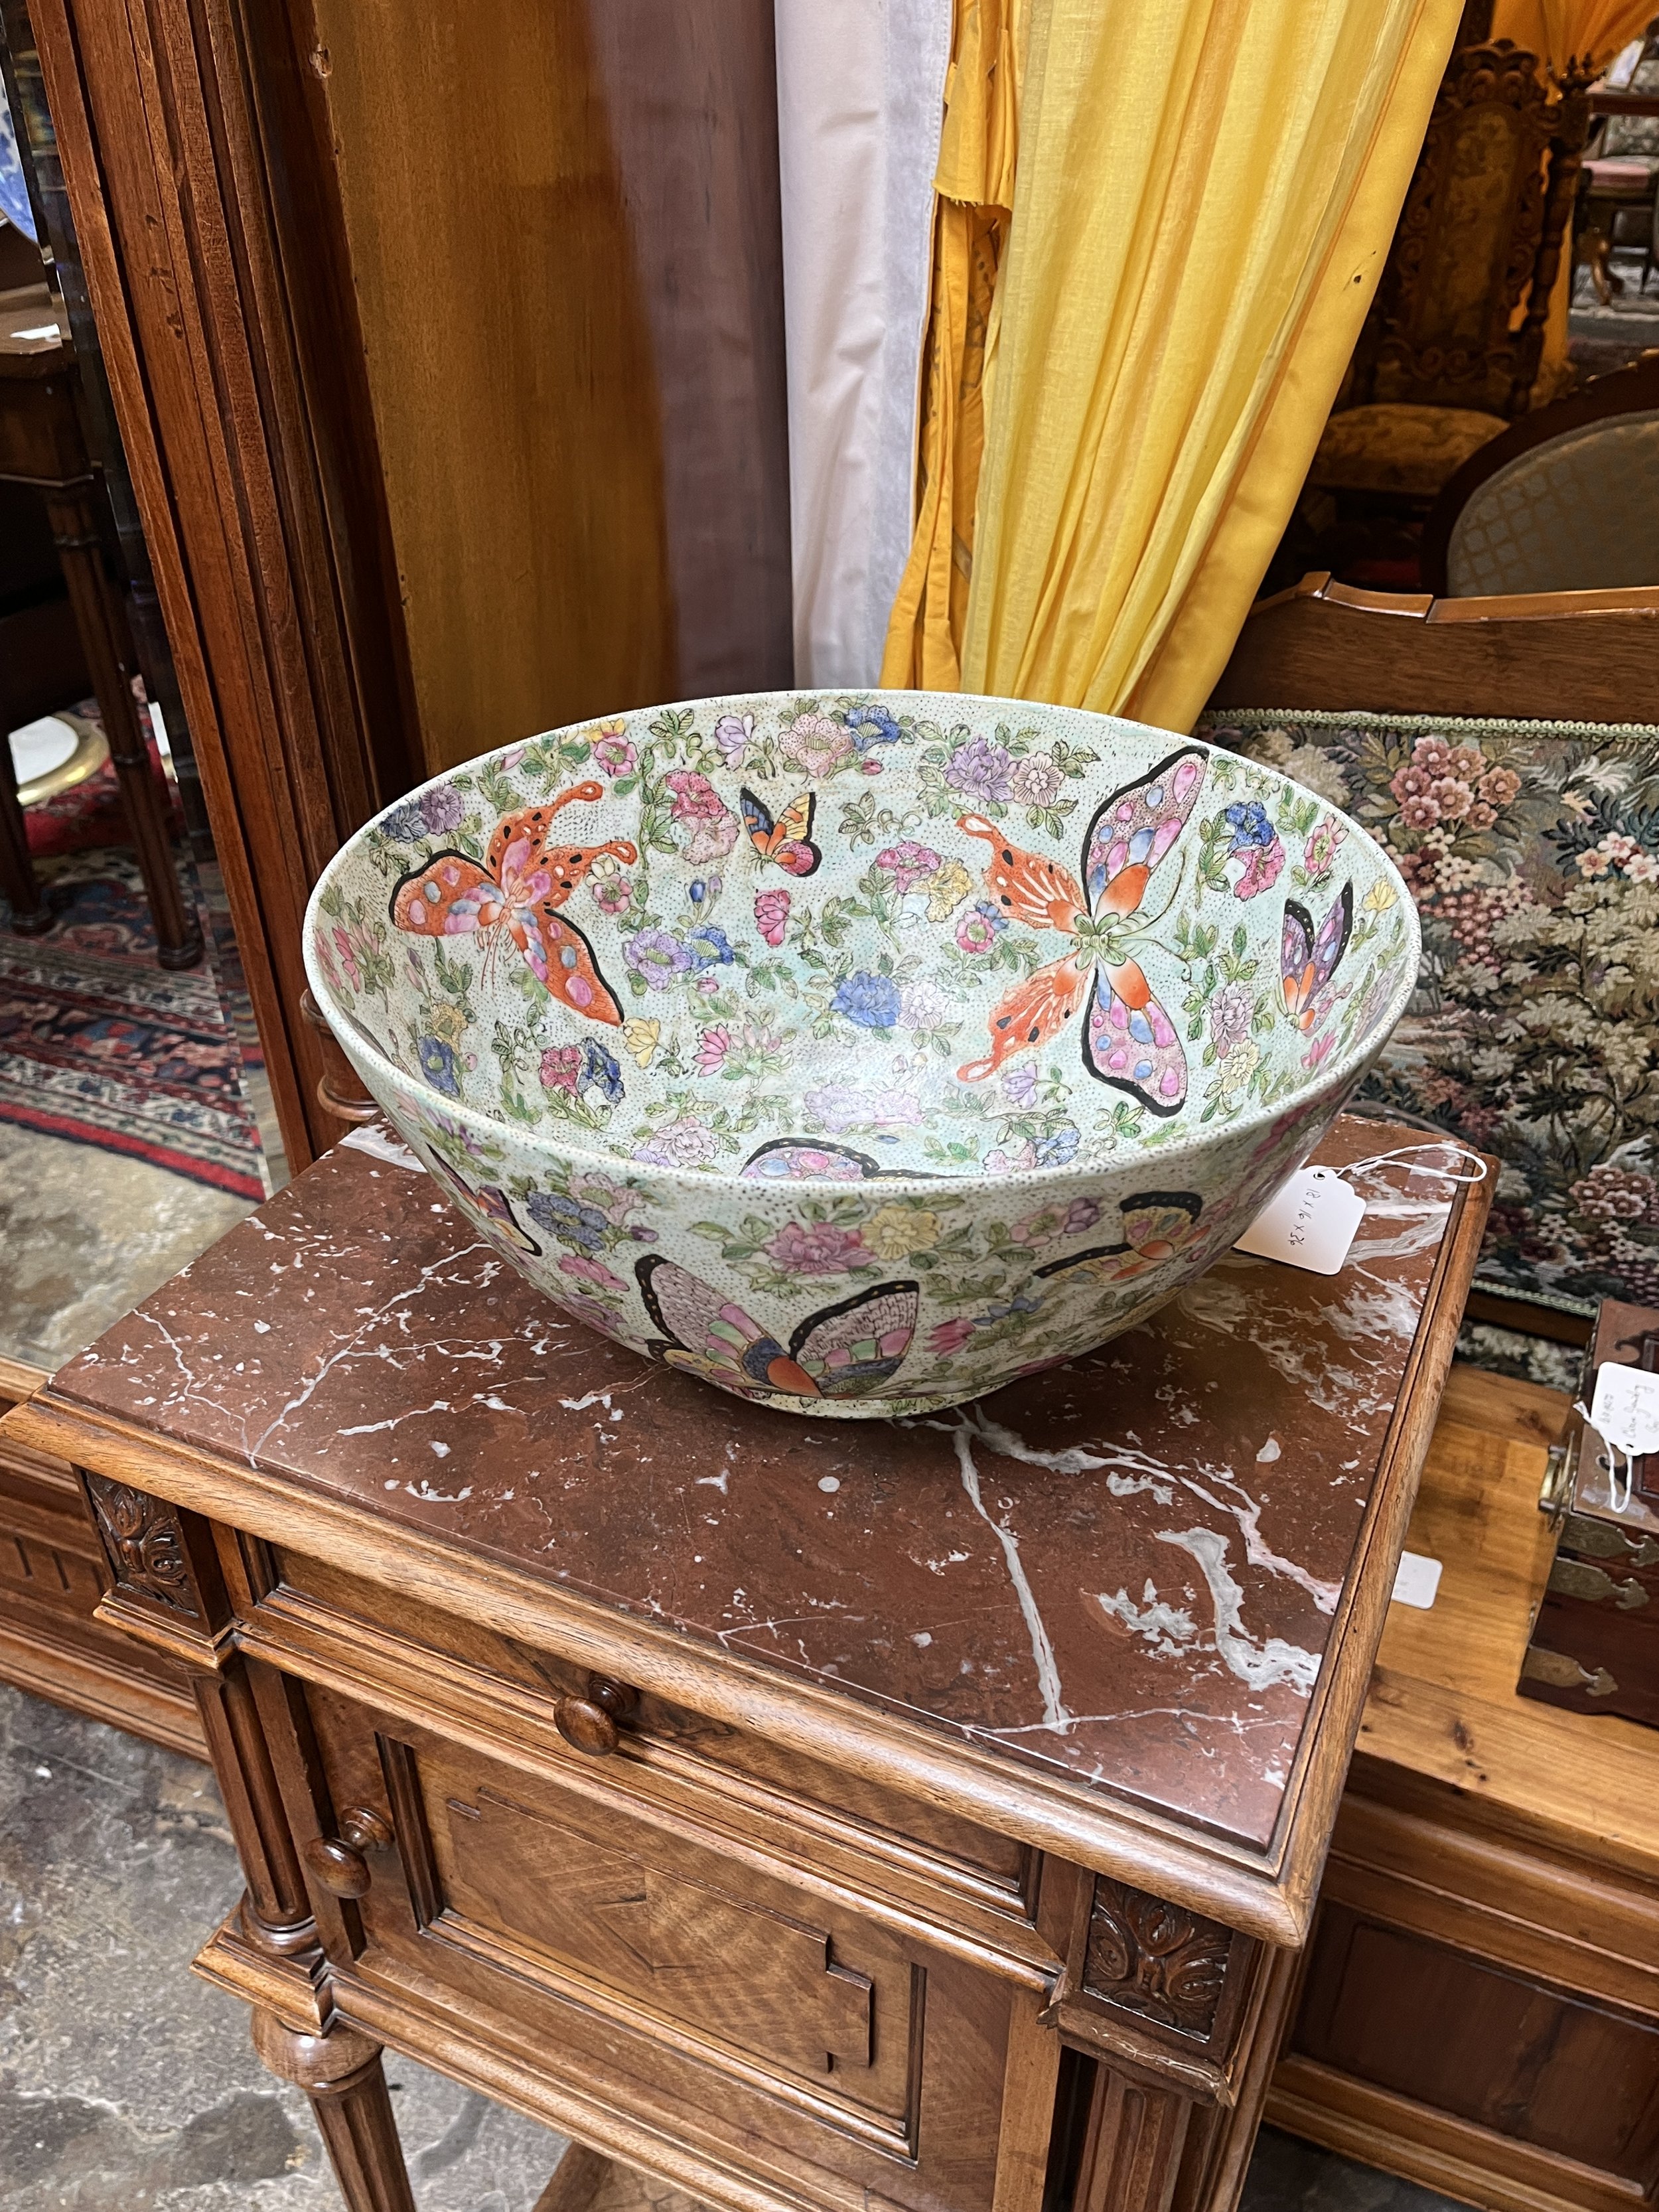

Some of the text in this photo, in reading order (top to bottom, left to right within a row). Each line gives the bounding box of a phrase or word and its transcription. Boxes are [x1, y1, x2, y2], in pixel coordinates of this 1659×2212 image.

[1306, 1188, 1321, 1198] 18
[1298, 1209, 1312, 1220] 16
[1287, 1232, 1305, 1246] 36
